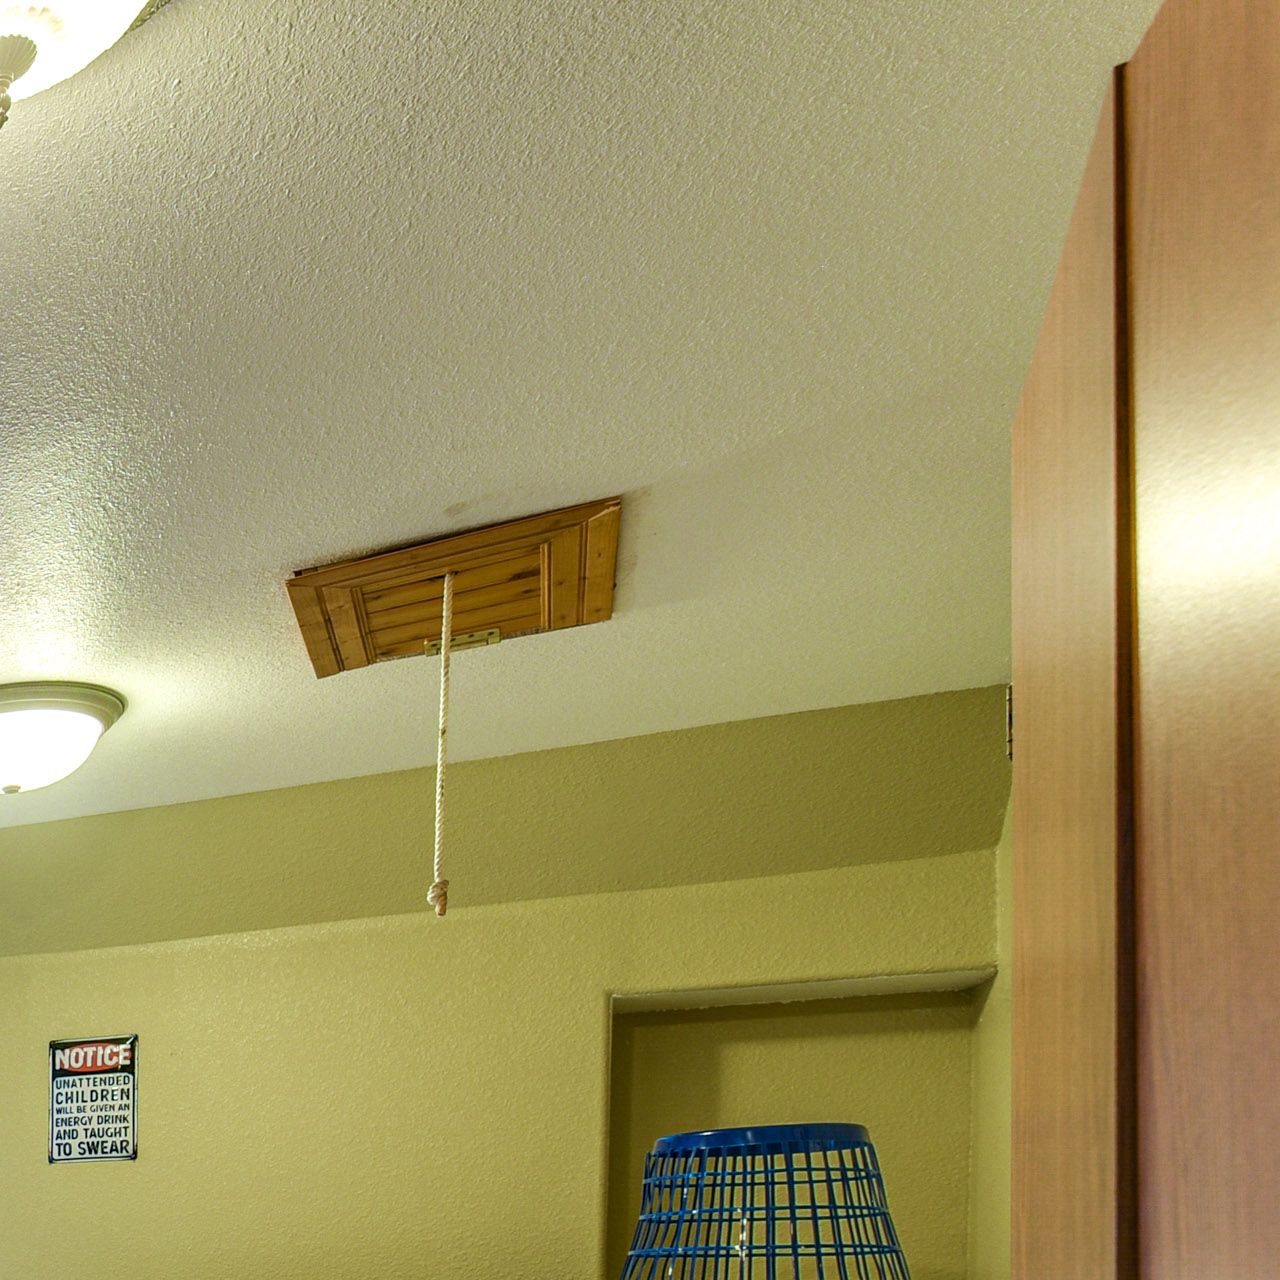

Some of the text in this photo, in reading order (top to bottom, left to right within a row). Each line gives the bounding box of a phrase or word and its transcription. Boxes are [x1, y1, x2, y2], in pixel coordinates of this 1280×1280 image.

[55, 1044, 131, 1070] NOTICE
[55, 1075, 130, 1089] UNATTENDED
[55, 1088, 130, 1105] CHILDREN
[55, 1103, 130, 1115] WILL BE GIVEN AN
[55, 1114, 130, 1127] ENERGY DRINK
[55, 1126, 130, 1140] AND TAUGHT
[55, 1139, 130, 1156] TO SWEAR
